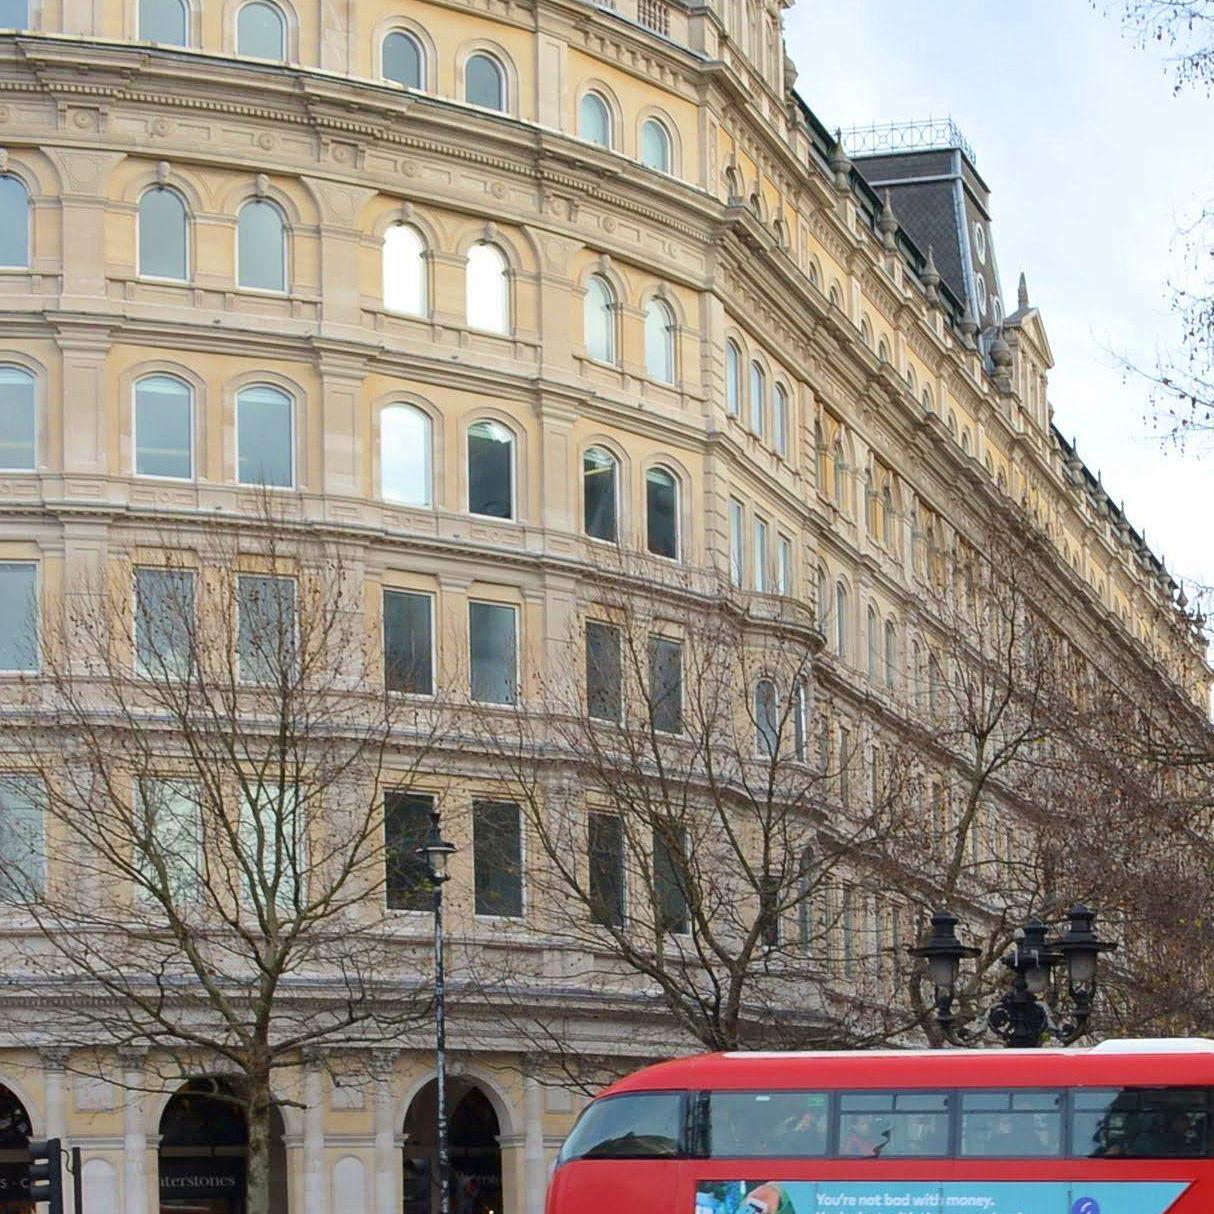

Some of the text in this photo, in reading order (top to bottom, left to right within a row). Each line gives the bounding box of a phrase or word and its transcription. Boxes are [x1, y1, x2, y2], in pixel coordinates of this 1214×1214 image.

[816, 1193, 857, 1206] You're
[859, 1194, 882, 1207] not
[884, 1193, 910, 1207] bad
[946, 1195, 996, 1209] money.
